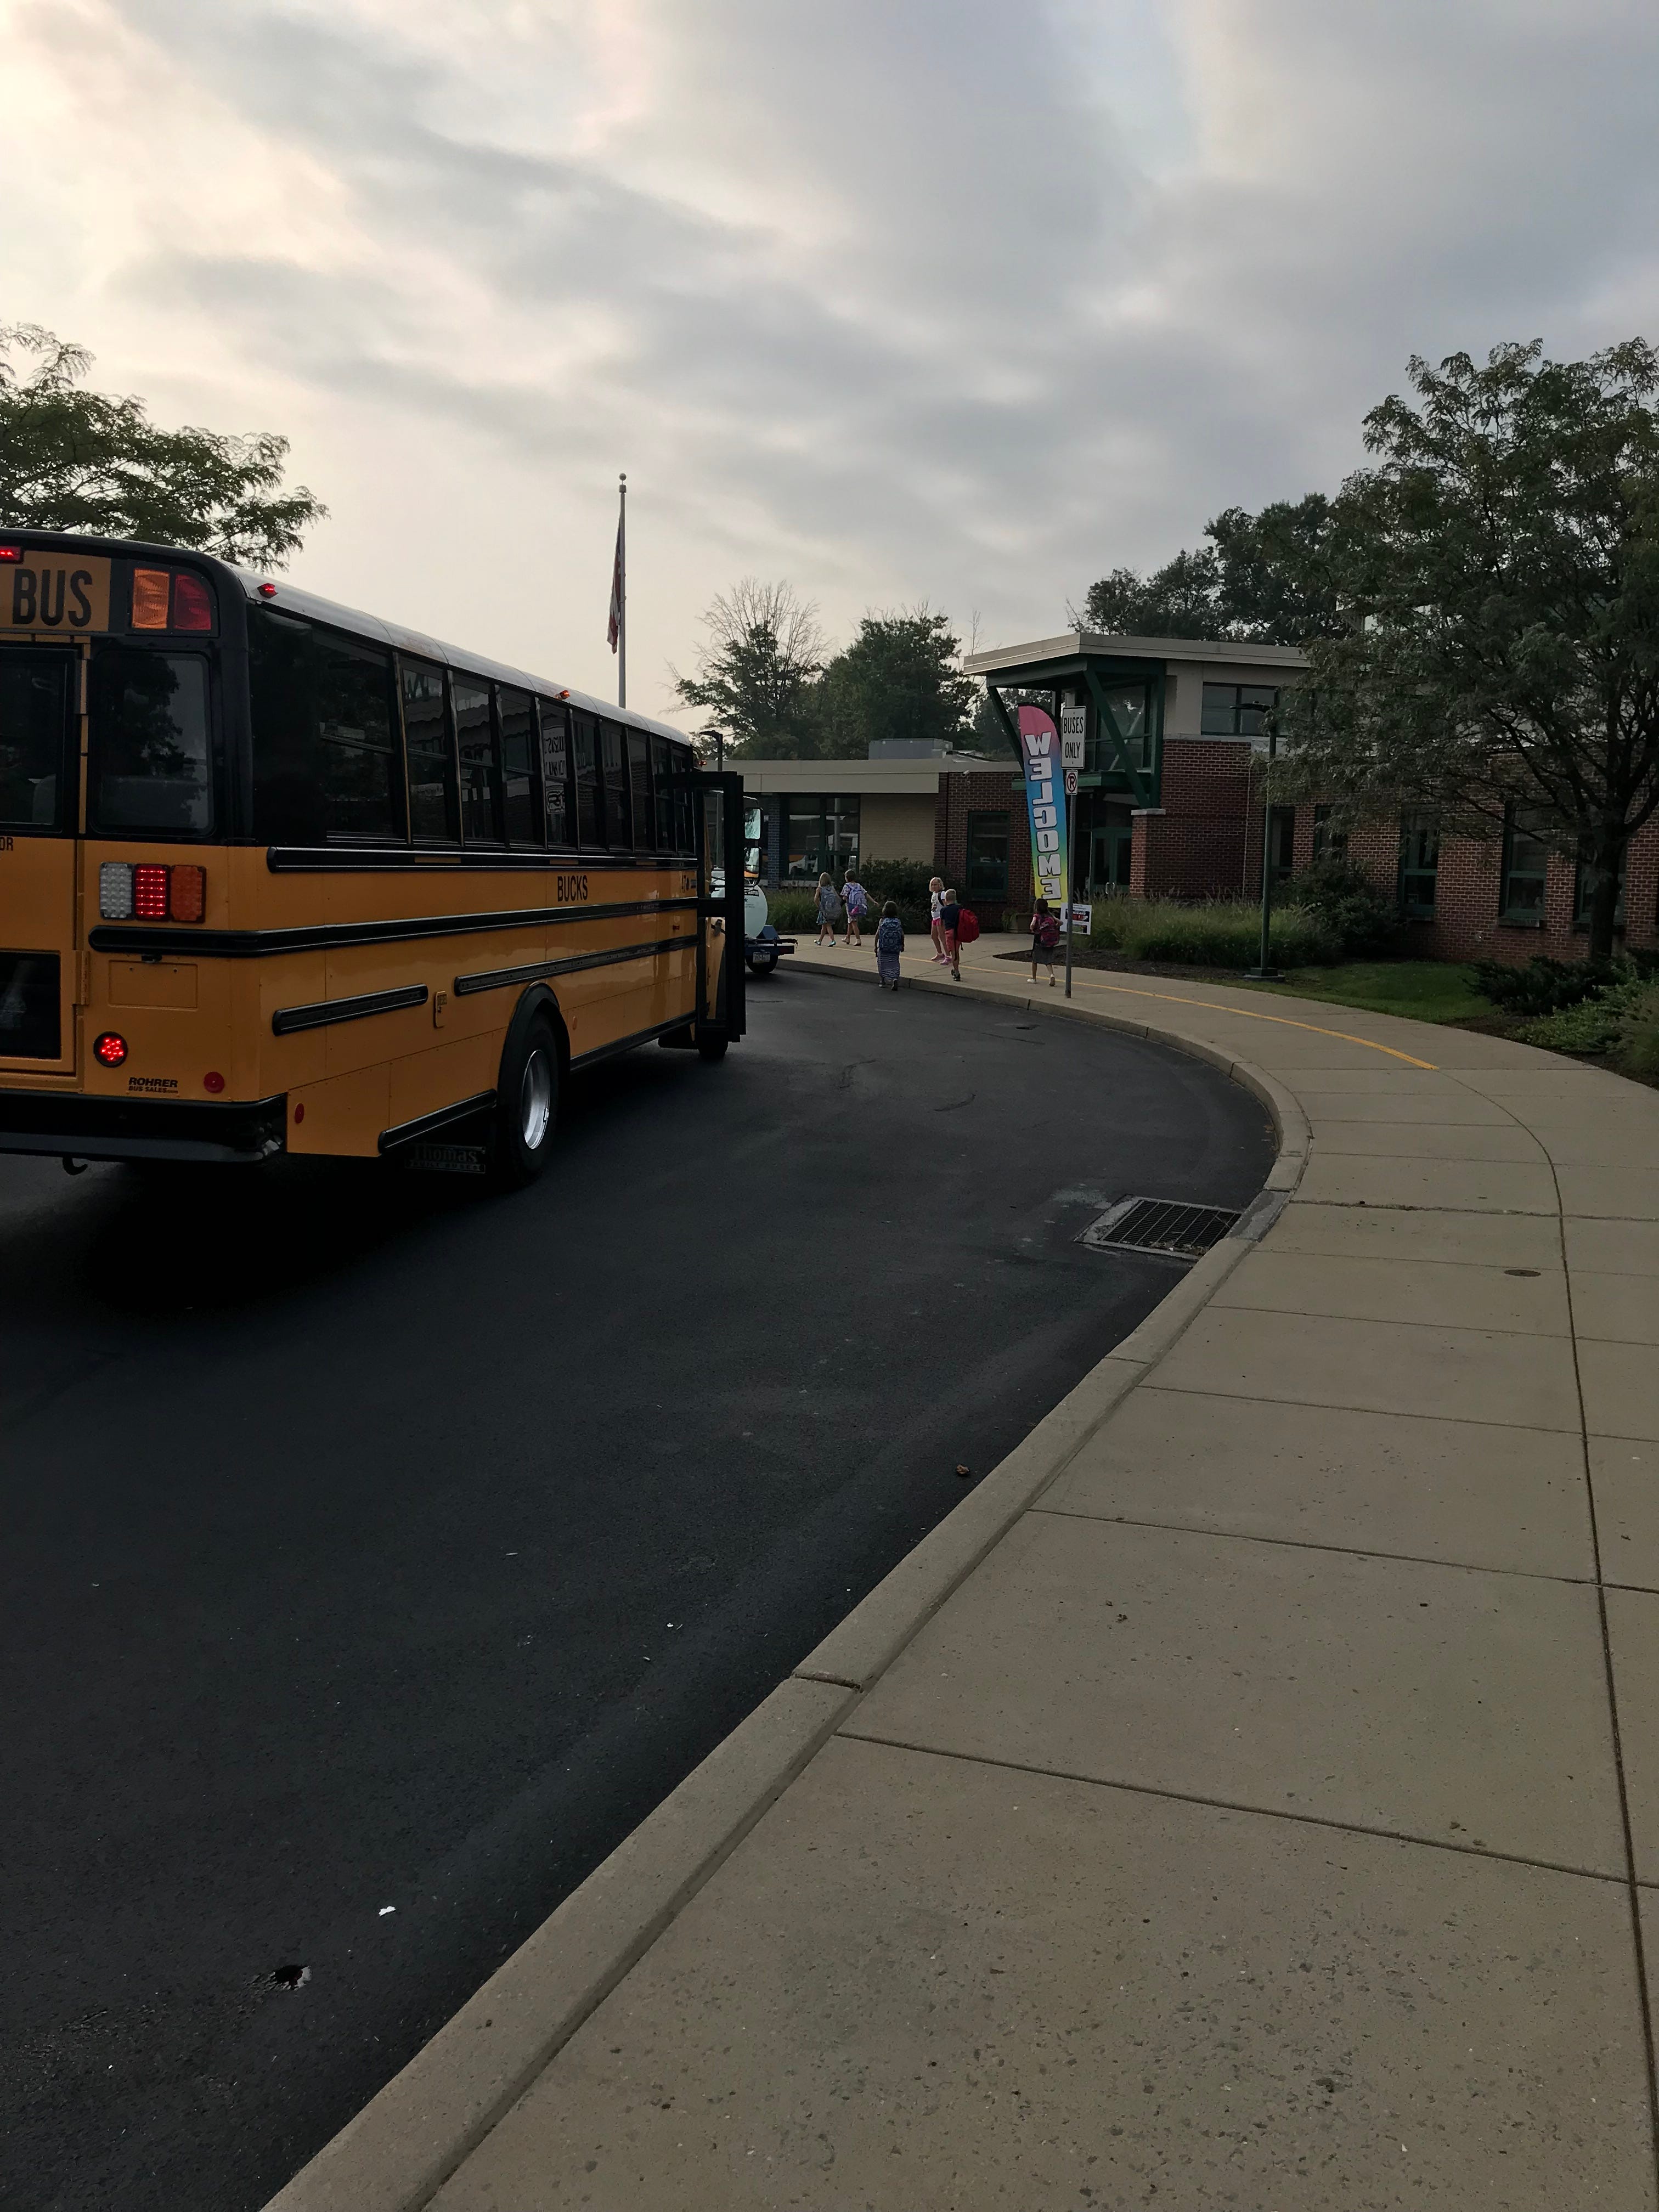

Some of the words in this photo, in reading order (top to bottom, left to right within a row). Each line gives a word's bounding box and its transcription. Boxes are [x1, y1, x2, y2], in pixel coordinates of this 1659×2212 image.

[12, 568, 93, 628] BUS
[1063, 716, 1084, 734] BUSES
[1065, 742, 1081, 759] ONLY
[557, 875, 589, 902] BUCKS
[128, 1077, 178, 1087] ROHRER
